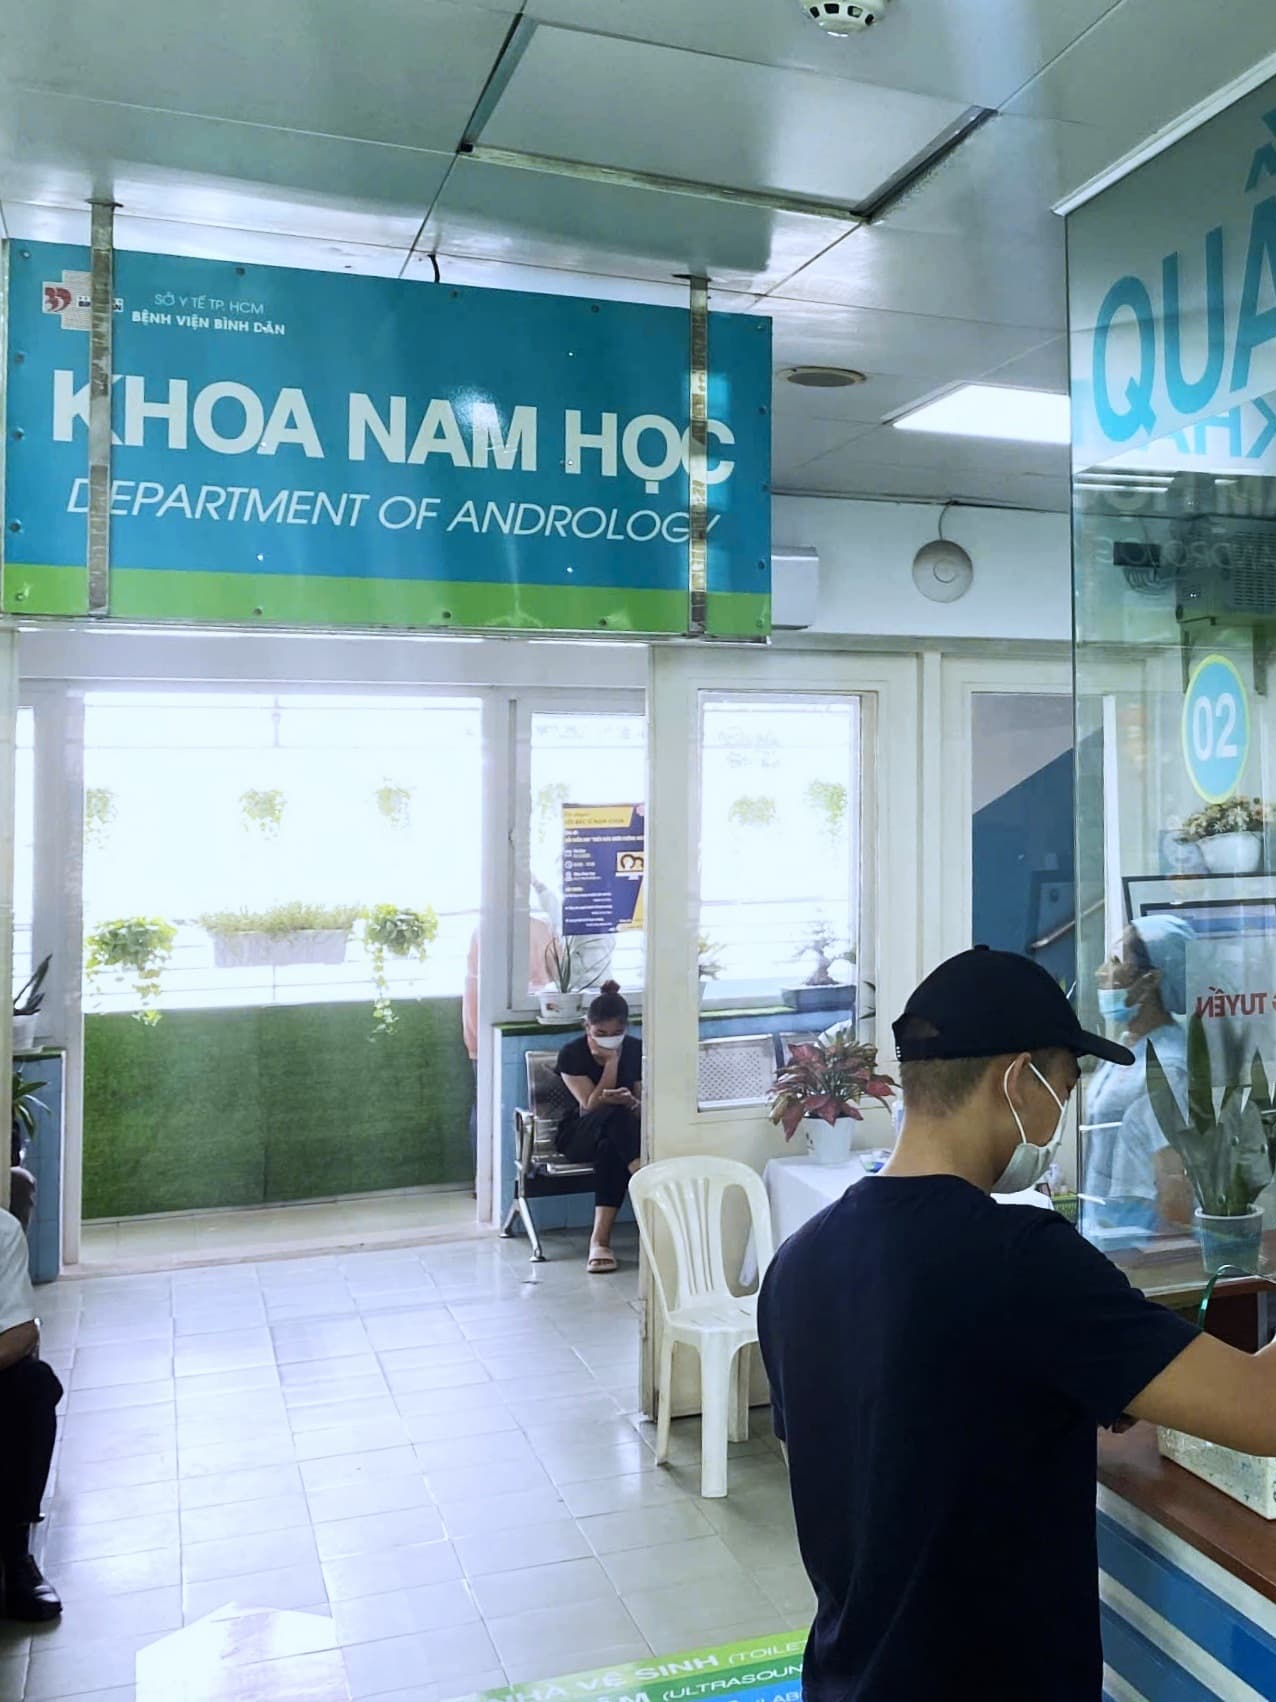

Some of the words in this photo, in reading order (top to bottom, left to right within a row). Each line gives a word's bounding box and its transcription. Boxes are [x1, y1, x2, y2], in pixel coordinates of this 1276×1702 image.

[131, 308, 172, 328] BỆNH
[175, 312, 210, 331] VIỆN
[214, 315, 249, 333] BÌNH
[153, 291, 176, 307] SỞ
[180, 296, 191, 308] Y
[191, 294, 207, 310] TẾ
[229, 300, 265, 315] HCM
[53, 369, 325, 459] KHOA
[349, 391, 538, 472] NAM
[565, 409, 736, 494] HỌC
[378, 495, 441, 531] OF
[1192, 692, 1239, 761] 02
[634, 1654, 720, 1681] SINH
[662, 1663, 804, 1702] (ULTRASOUN
